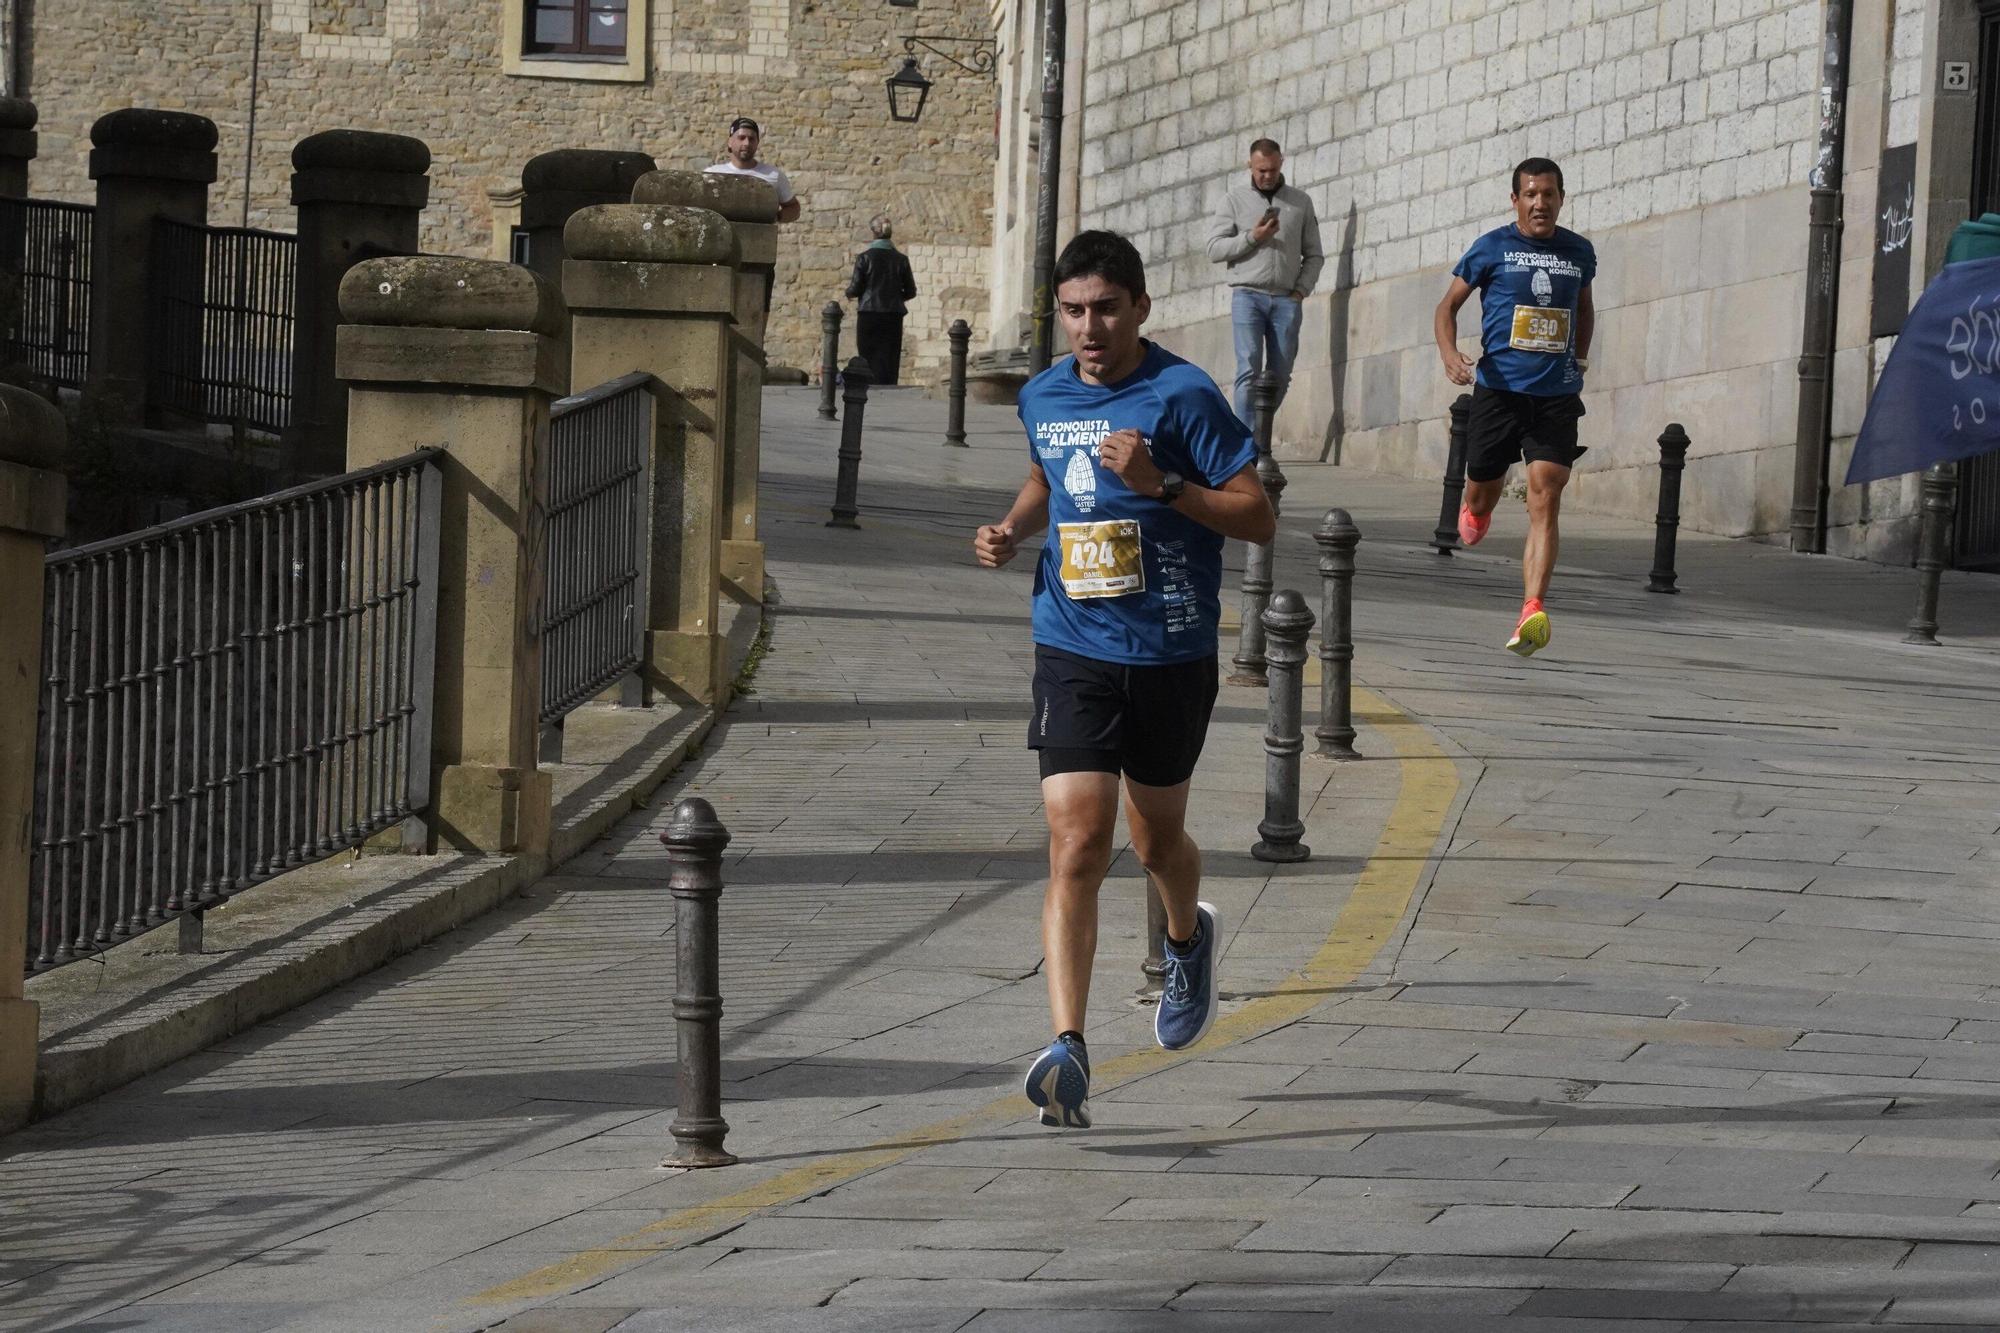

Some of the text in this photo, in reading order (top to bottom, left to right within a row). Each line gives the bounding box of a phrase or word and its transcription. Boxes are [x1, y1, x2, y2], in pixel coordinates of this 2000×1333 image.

[1514, 252, 1558, 261] CONQUISTA
[1517, 258, 1573, 270] ALMENDRA
[1528, 318, 1558, 336] 330
[1036, 420, 1111, 433] LA CONQUISTA
[1036, 432, 1043, 440] DE
[1070, 541, 1116, 570] 424
[1083, 571, 1105, 579] DANIEL
